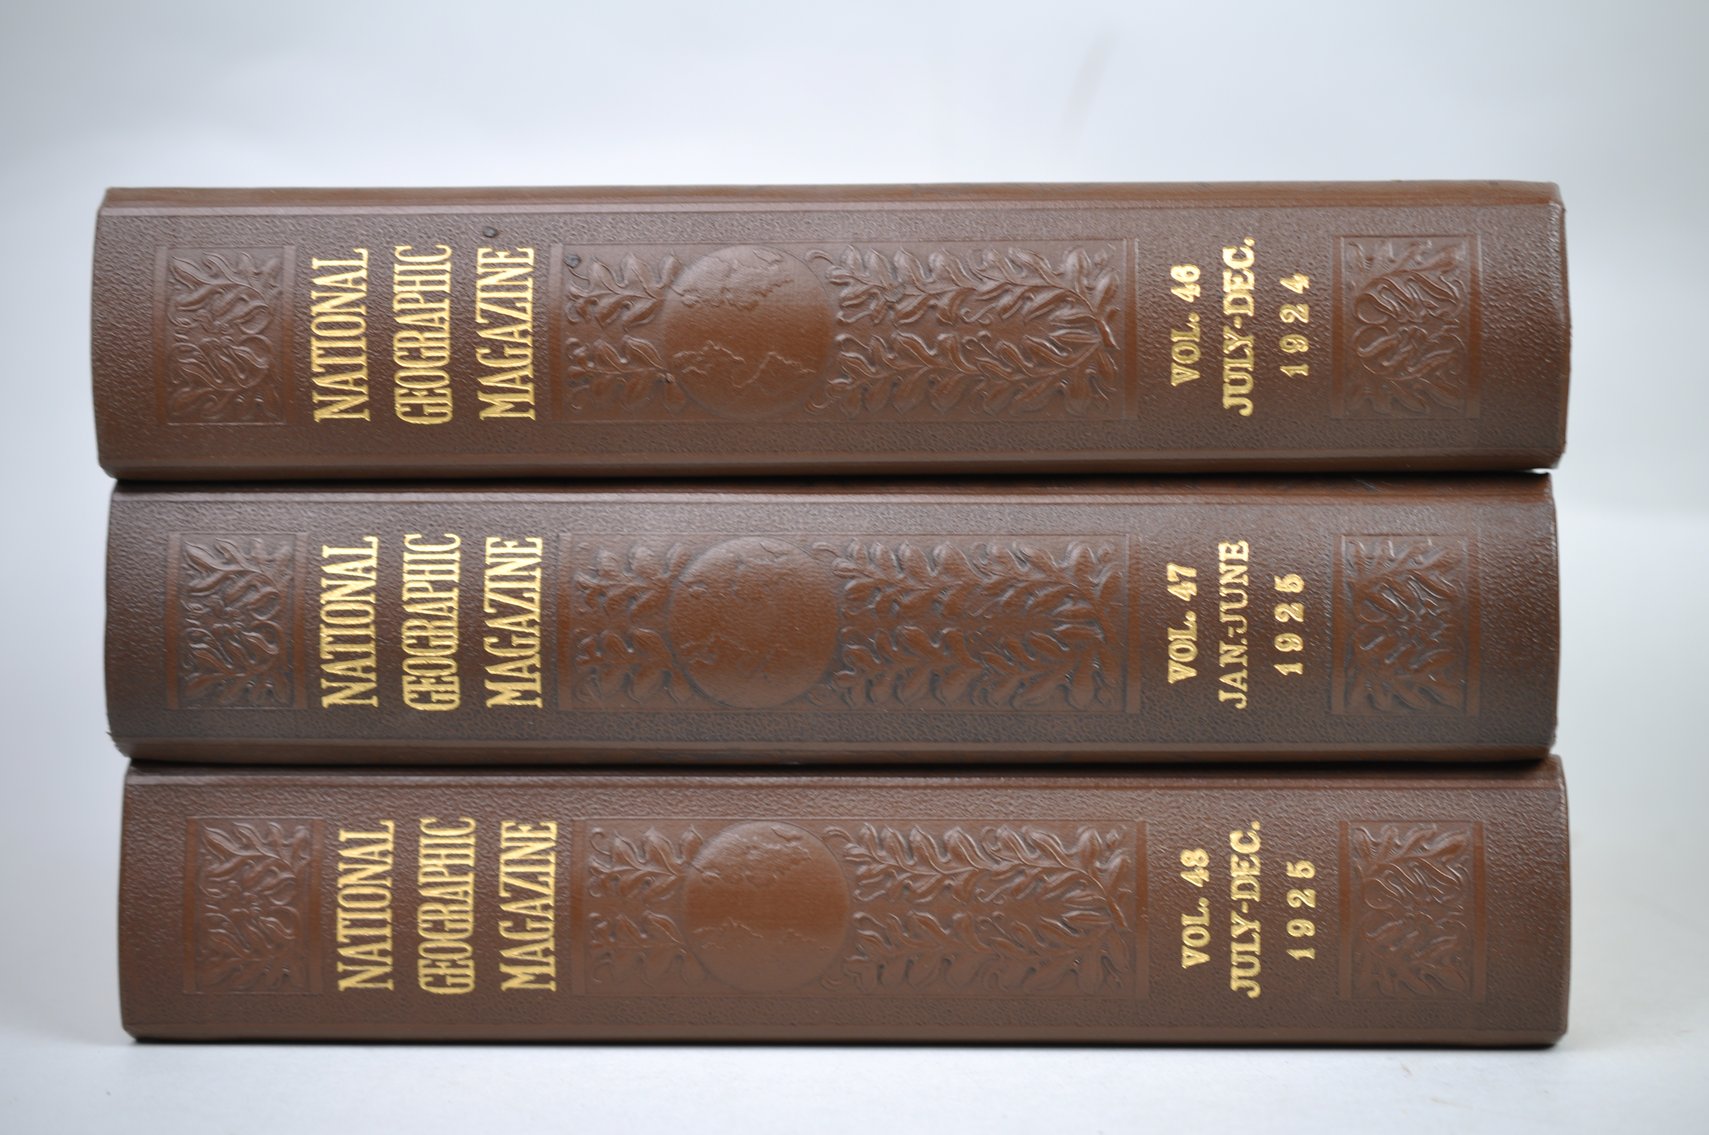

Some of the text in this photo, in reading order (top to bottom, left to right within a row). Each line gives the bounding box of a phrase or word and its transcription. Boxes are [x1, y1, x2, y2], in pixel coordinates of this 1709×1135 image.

[309, 247, 371, 423] NATIONAL
[391, 243, 453, 425] GEOGRAPHIC
[474, 246, 536, 421] MAGAZINE
[1169, 262, 1202, 387] VOL. 46
[1222, 236, 1256, 417] JULY-DEC.
[1278, 272, 1312, 378] 1924
[319, 534, 379, 709] NATIONAL
[400, 533, 463, 711] GEOGRAPHIC
[482, 536, 545, 709] MAGAZINE
[1166, 561, 1198, 685] VOL. 47
[1273, 573, 1305, 676] 1925
[336, 819, 396, 992] NATIONAL
[416, 816, 477, 995] GEOGRAPHIC
[497, 819, 559, 992] MAGAZINE
[1179, 847, 1211, 970] VOL. 48
[1228, 819, 1262, 999] JULY-DEC.
[1285, 859, 1317, 961] 1925
